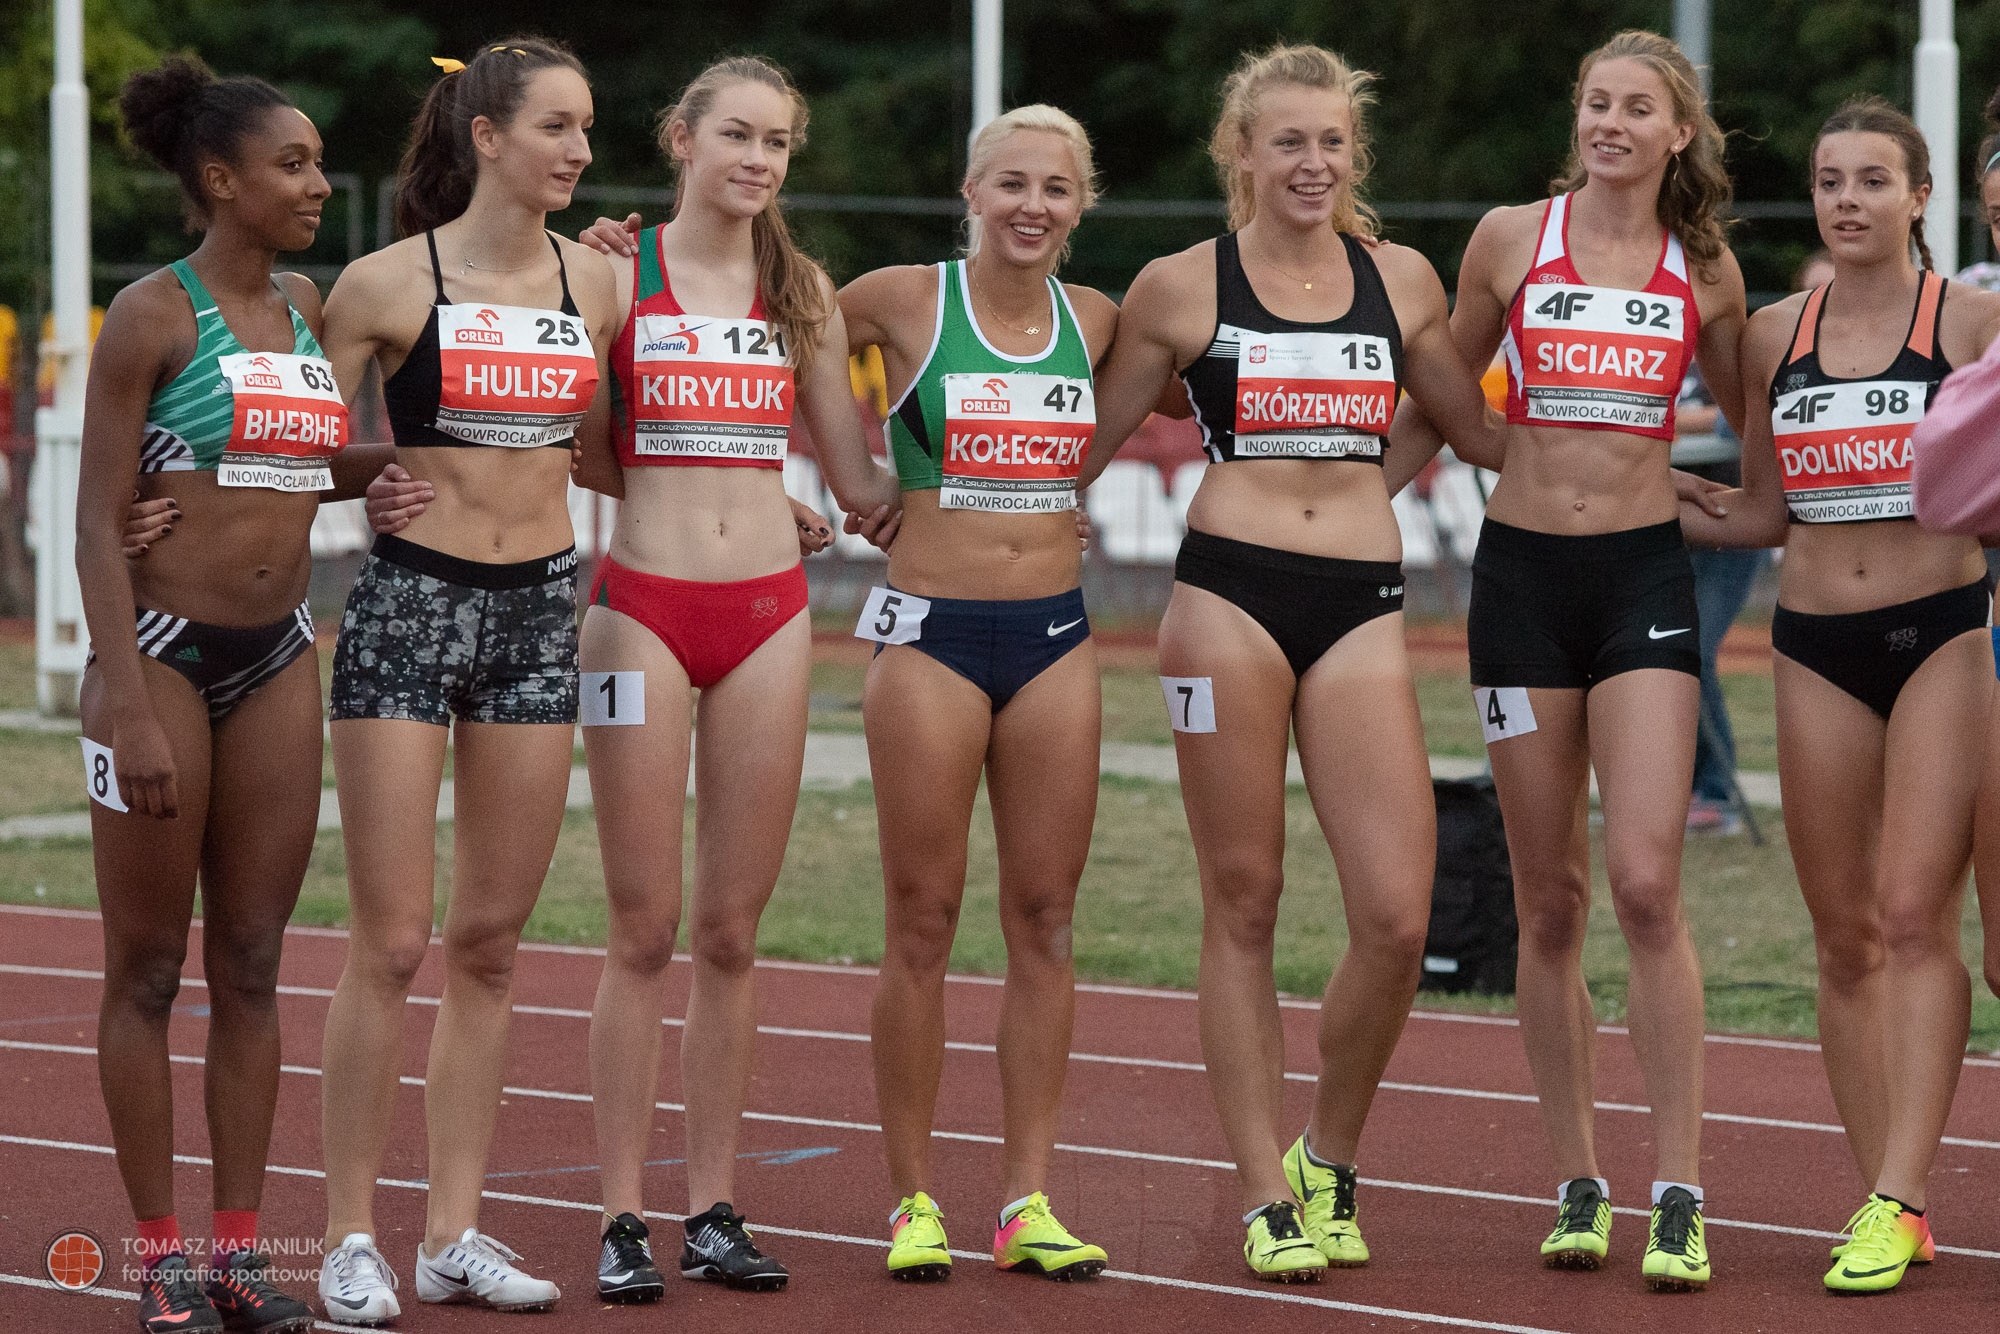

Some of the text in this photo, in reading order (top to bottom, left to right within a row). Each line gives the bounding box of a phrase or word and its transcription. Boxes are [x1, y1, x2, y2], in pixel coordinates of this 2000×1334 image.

[1535, 291, 1594, 321] 4F
[1625, 299, 1670, 330] 92
[458, 331, 501, 344] ORLEN
[535, 318, 580, 347] 25
[642, 340, 687, 354] polanik
[724, 327, 786, 358] 121
[1341, 342, 1382, 371] 15
[1537, 342, 1667, 382] SICIARZ
[246, 374, 281, 388] ORLEN
[300, 363, 334, 393] 63
[465, 363, 578, 400] HULISZ
[642, 375, 787, 411] KIRYLUK
[963, 400, 1008, 413] ORLEN
[1043, 383, 1083, 413] 47
[1241, 386, 1387, 425] SKÓRZEWSKA
[1593, 393, 1649, 404] MISTRZOSTWA
[1781, 391, 1836, 424] 4F
[1865, 388, 1910, 416] 98
[243, 408, 340, 448] BHEBHE
[440, 410, 461, 419] PZLA
[462, 412, 513, 423] DRUŻYNOWE
[1535, 403, 1659, 424] INOWROCŁAW 2018
[446, 424, 546, 444] INOWROCŁAW
[658, 423, 709, 432] DRUŻYNOWE
[710, 426, 763, 435] MISTRZOSTWA
[764, 428, 787, 436] POLSKI
[645, 439, 778, 456] INOWROCŁAW 2018
[950, 433, 1087, 465] KOŁECZEK
[1245, 440, 1375, 453] INOWROCŁAW 2018
[1781, 435, 1915, 477] DOLIŃSKA
[227, 470, 310, 488] INOWROCŁAW
[965, 480, 1016, 489] DRUŻYNOWE
[1848, 487, 1900, 497] MISTRZOSTWA
[950, 493, 1052, 510] INOWROCŁAW
[1796, 500, 1912, 519] INOWROCŁAW 201
[874, 595, 903, 637] 5
[599, 674, 616, 719] 1
[1177, 686, 1193, 728] 7
[1487, 688, 1507, 731] 4
[94, 753, 109, 798] 8
